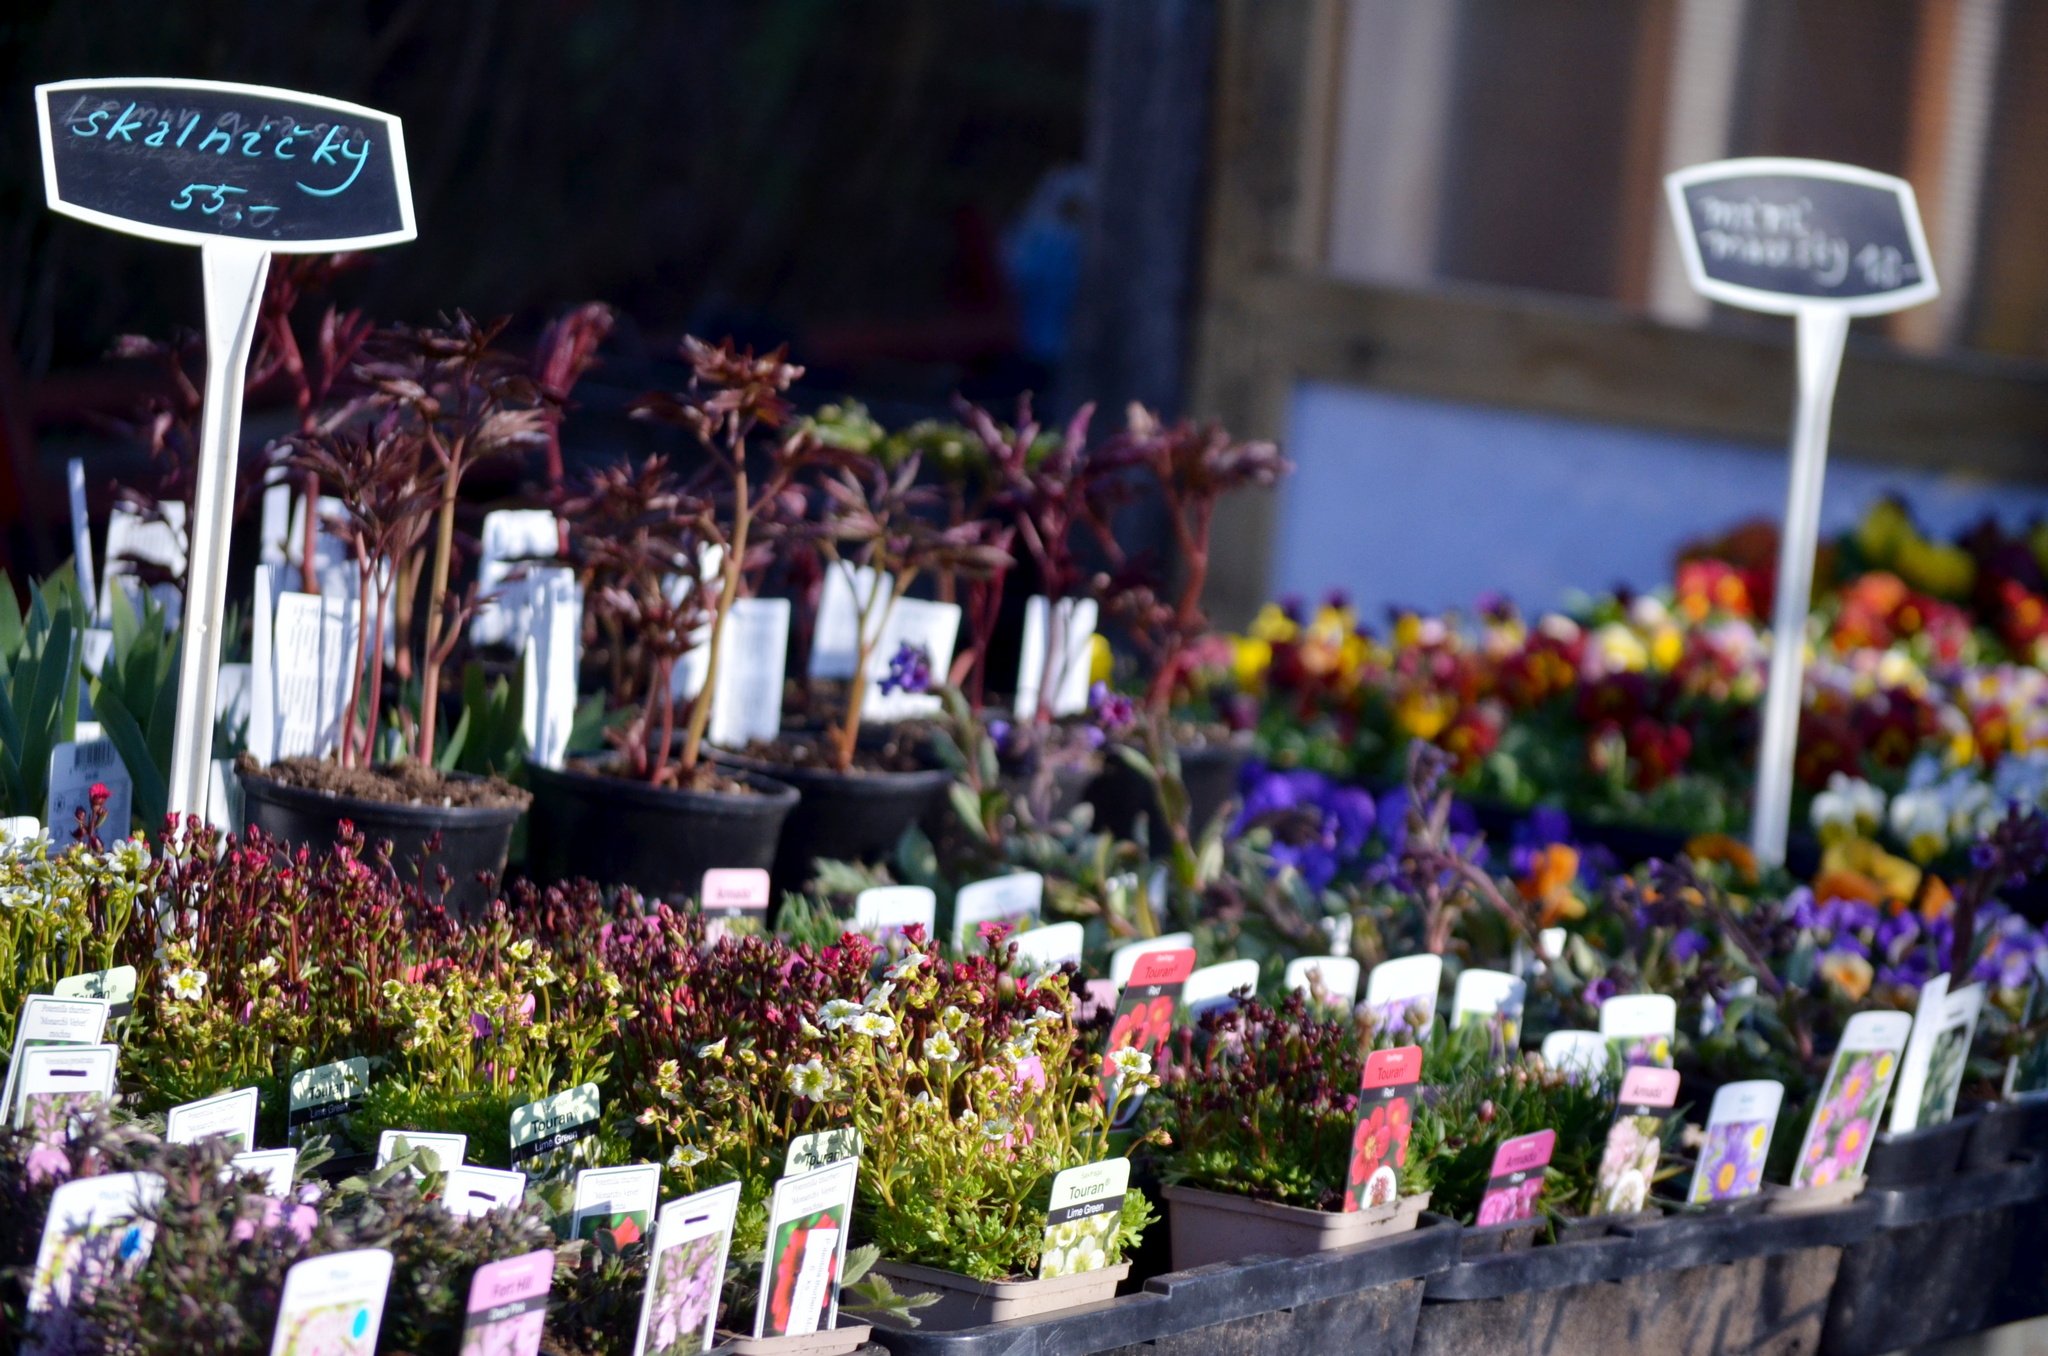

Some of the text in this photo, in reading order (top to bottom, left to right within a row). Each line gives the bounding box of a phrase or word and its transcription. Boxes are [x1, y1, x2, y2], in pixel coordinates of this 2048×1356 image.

[534, 1130, 578, 1153] Lime Green
[1066, 1203, 1105, 1219] Lime Green
